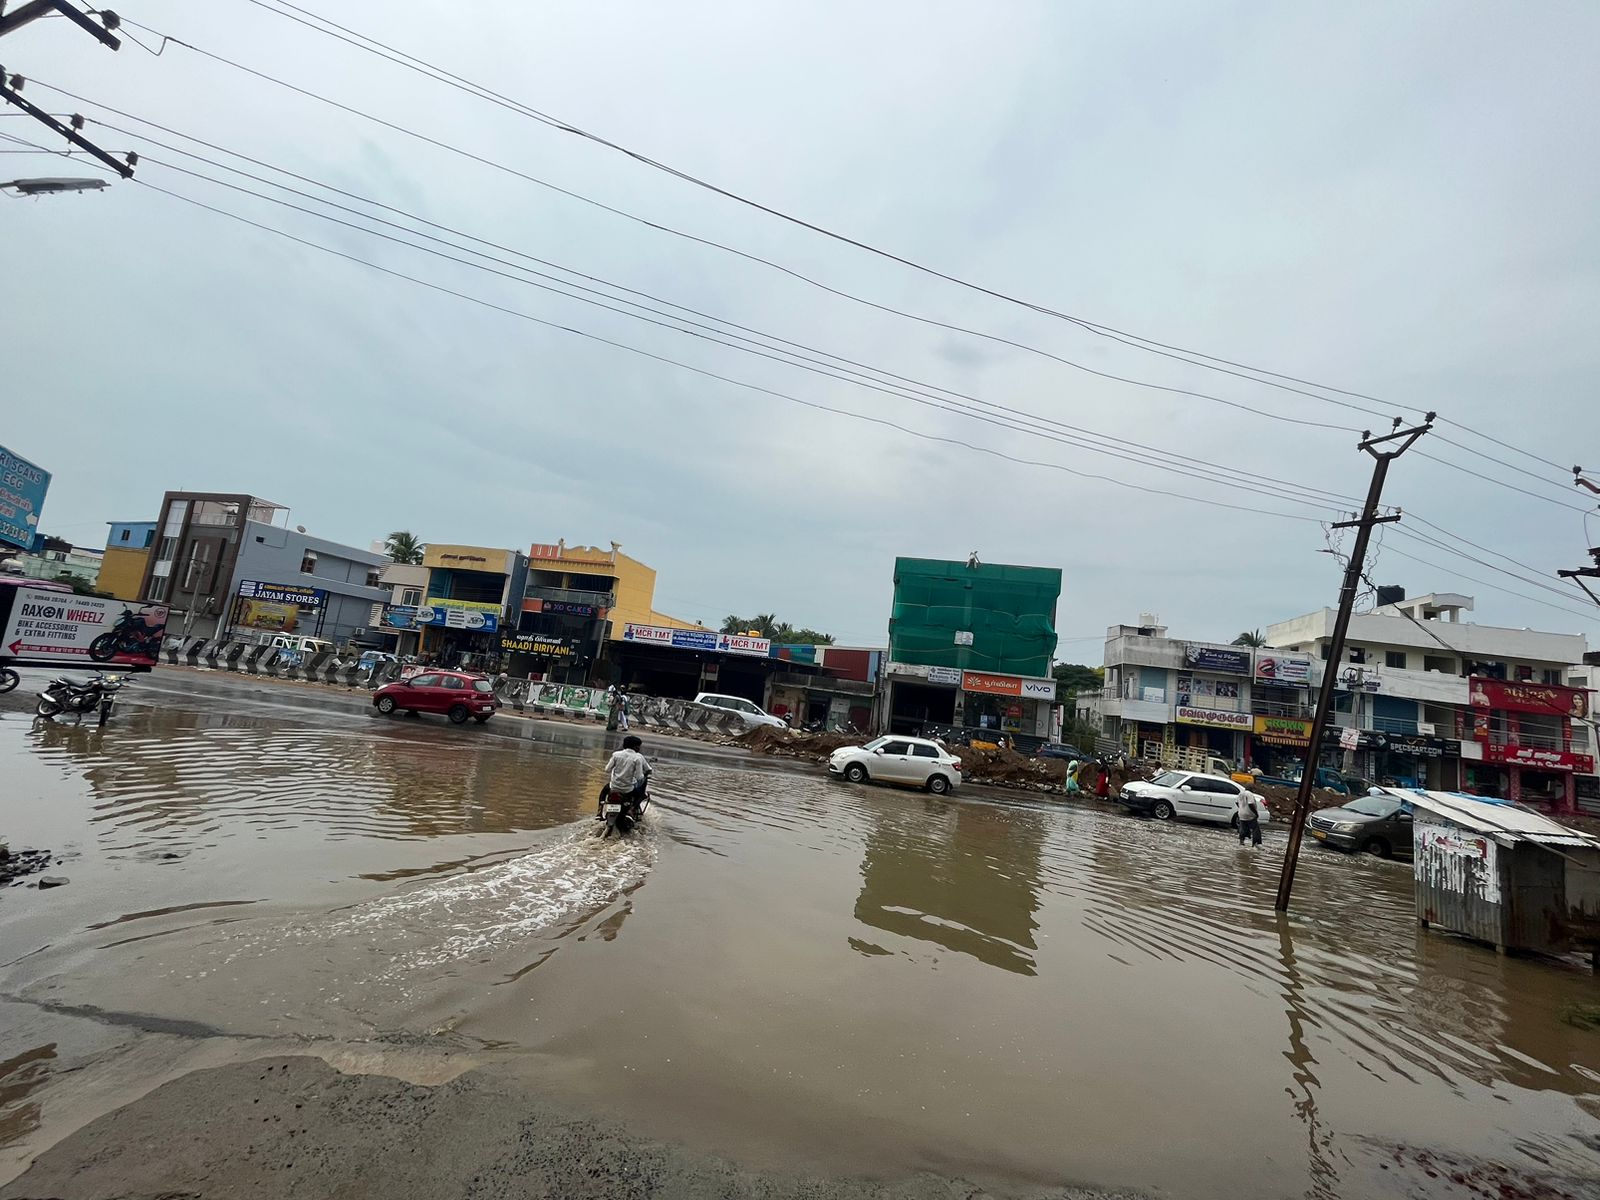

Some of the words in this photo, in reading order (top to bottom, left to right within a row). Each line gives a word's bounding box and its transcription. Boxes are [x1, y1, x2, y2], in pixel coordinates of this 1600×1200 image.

[11, 459, 41, 484] SCANS
[3, 471, 23, 489] ECG
[255, 590, 284, 600] JAYAM
[285, 593, 320, 605] STORES
[21, 603, 65, 620] RAXON
[66, 608, 105, 624] WHEELZ
[566, 605, 592, 614] CAKES
[17, 620, 34, 628] BIKE
[35, 621, 79, 633] ACCESSORIES
[24, 629, 46, 638] EXTRA
[47, 631, 77, 641] FITTINGS
[635, 629, 652, 638] MCR
[654, 630, 670, 639] TMT
[501, 639, 532, 650] SHAADI
[533, 642, 570, 656] BIRIYANI
[730, 639, 749, 648] MCR
[751, 641, 769, 650] TMT
[984, 680, 1018, 690] பூர்விகா
[1025, 683, 1051, 693] vivo
